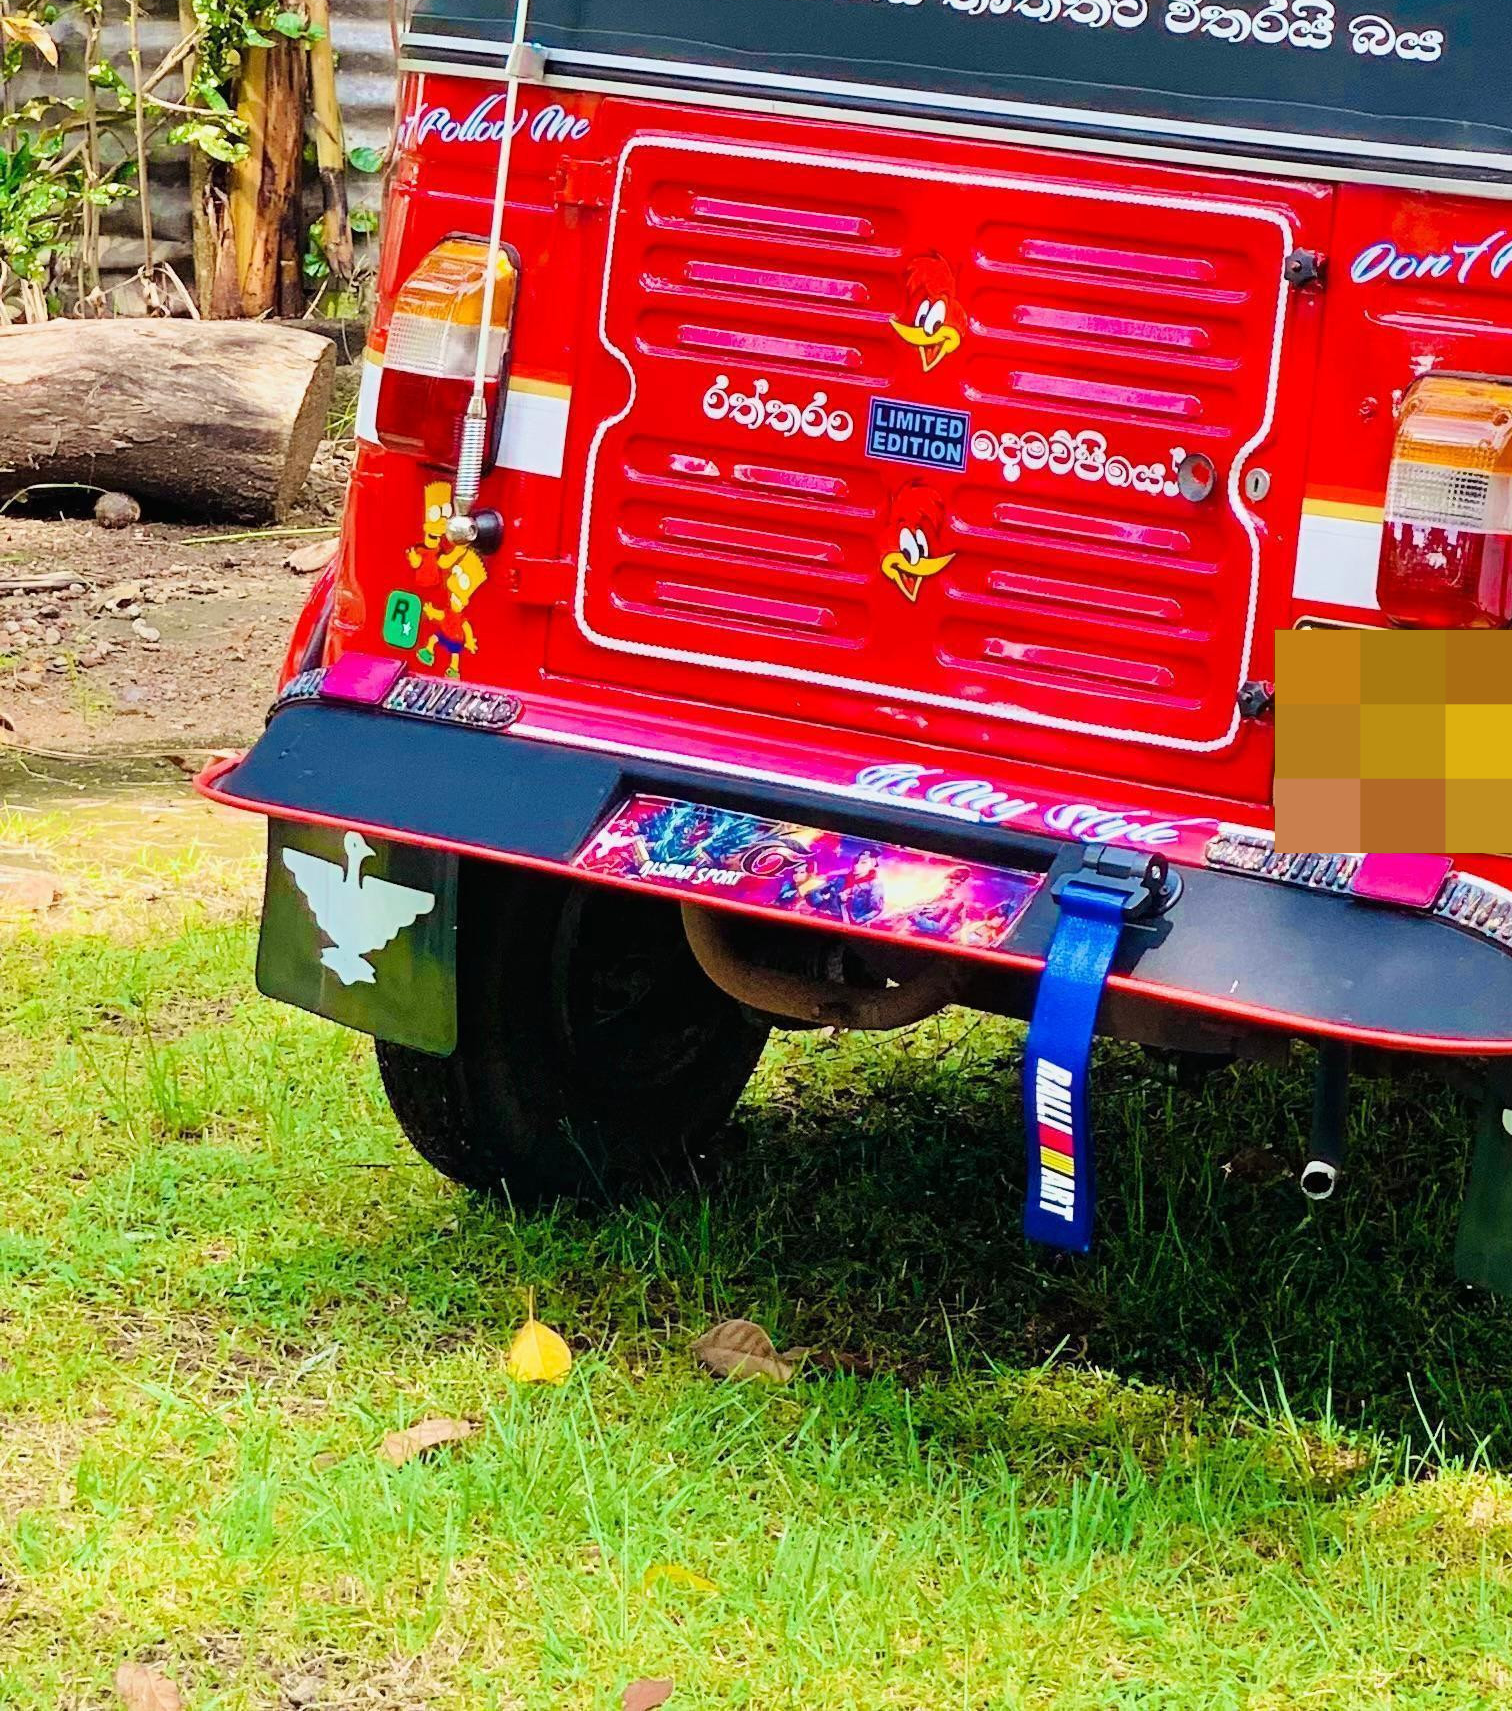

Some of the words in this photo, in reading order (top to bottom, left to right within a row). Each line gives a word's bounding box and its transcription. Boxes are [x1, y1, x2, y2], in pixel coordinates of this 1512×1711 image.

[1348, 14, 1444, 63] බය
[531, 104, 591, 143] Me
[875, 407, 964, 440] LIMITED
[872, 431, 963, 464] EDITION
[925, 779, 1038, 824] My
[1044, 804, 1219, 845] Style
[691, 866, 745, 886] SPORT
